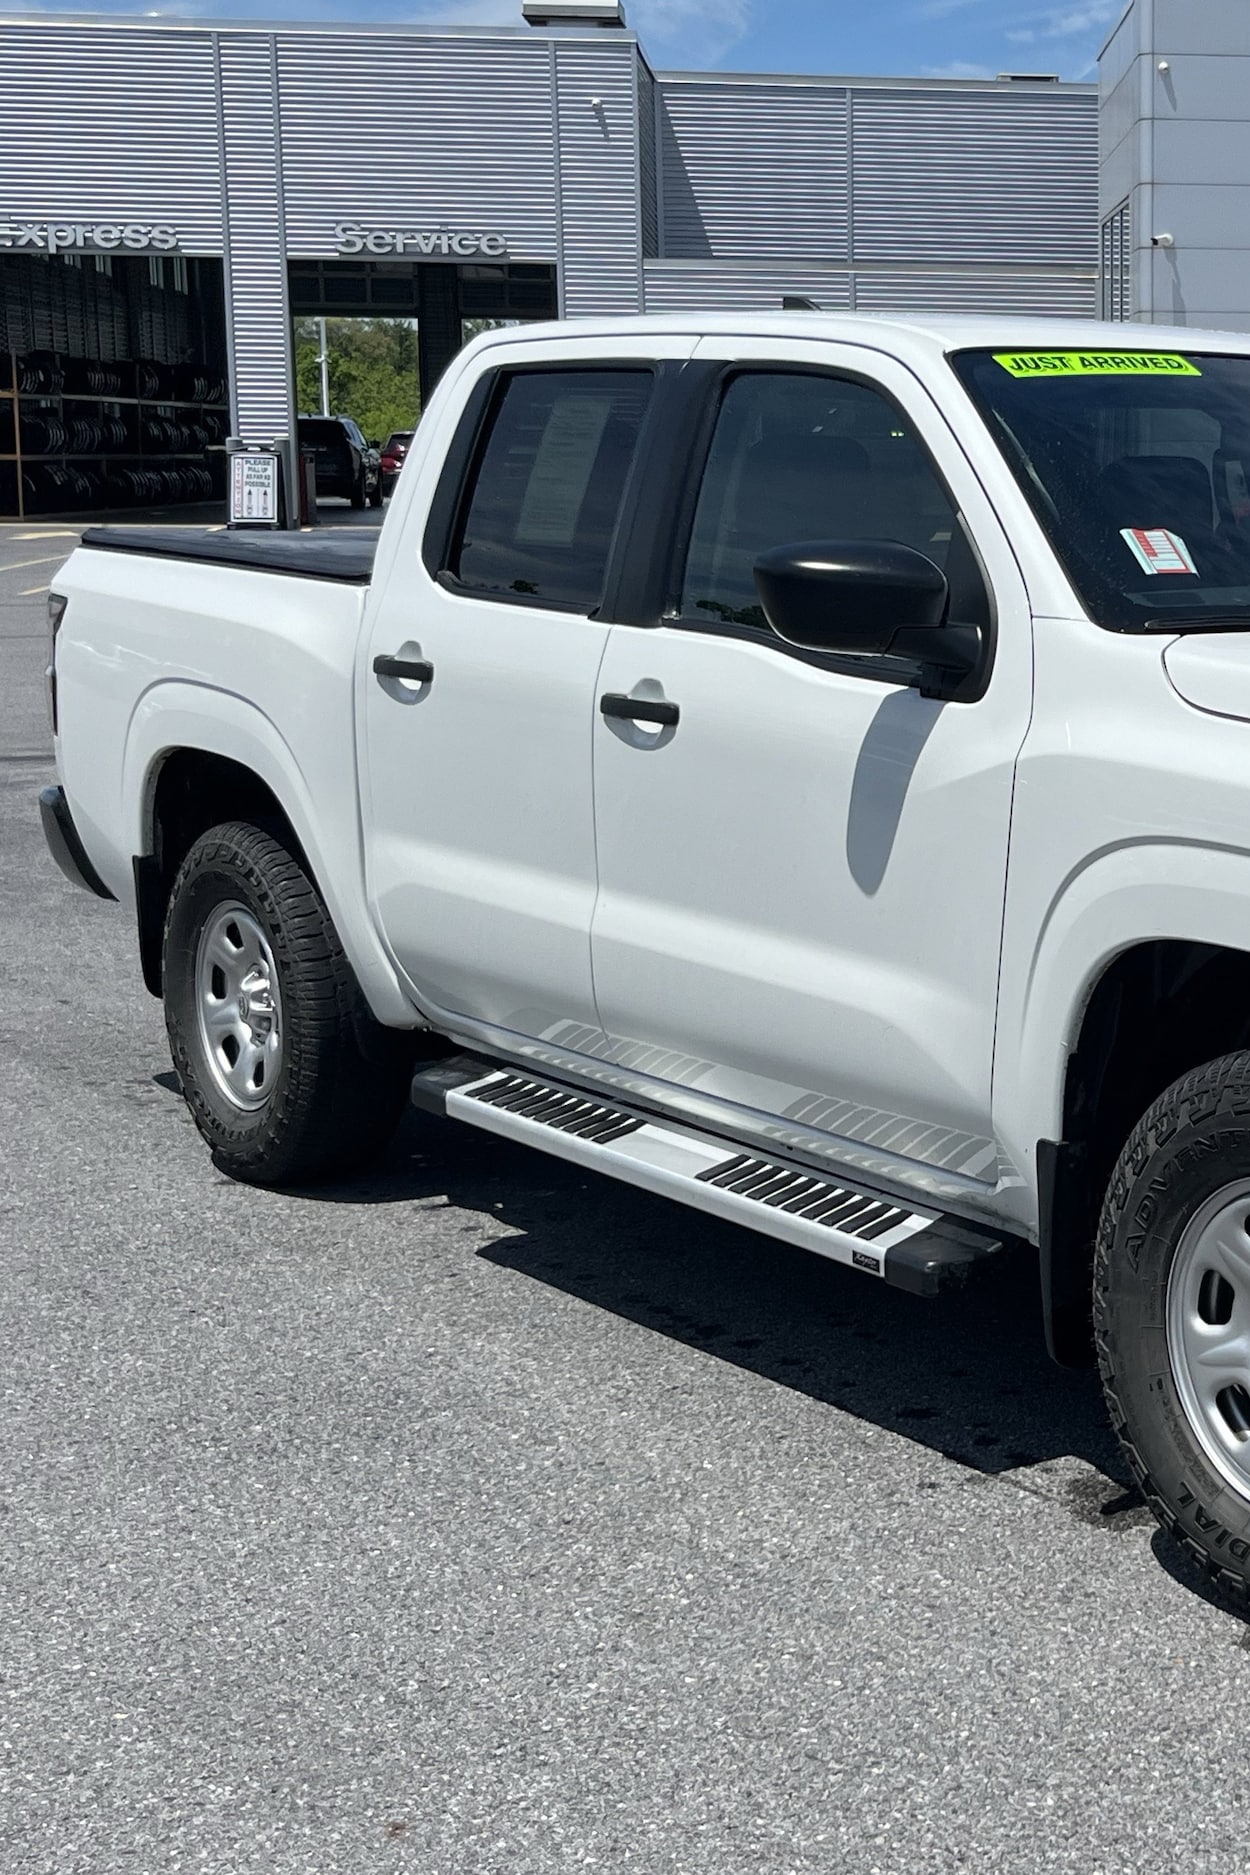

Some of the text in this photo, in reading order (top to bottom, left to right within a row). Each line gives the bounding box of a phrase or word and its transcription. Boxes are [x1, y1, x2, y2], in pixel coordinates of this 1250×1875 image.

[333, 222, 508, 256] Service
[1008, 355, 1187, 372] JUST ARRIVED
